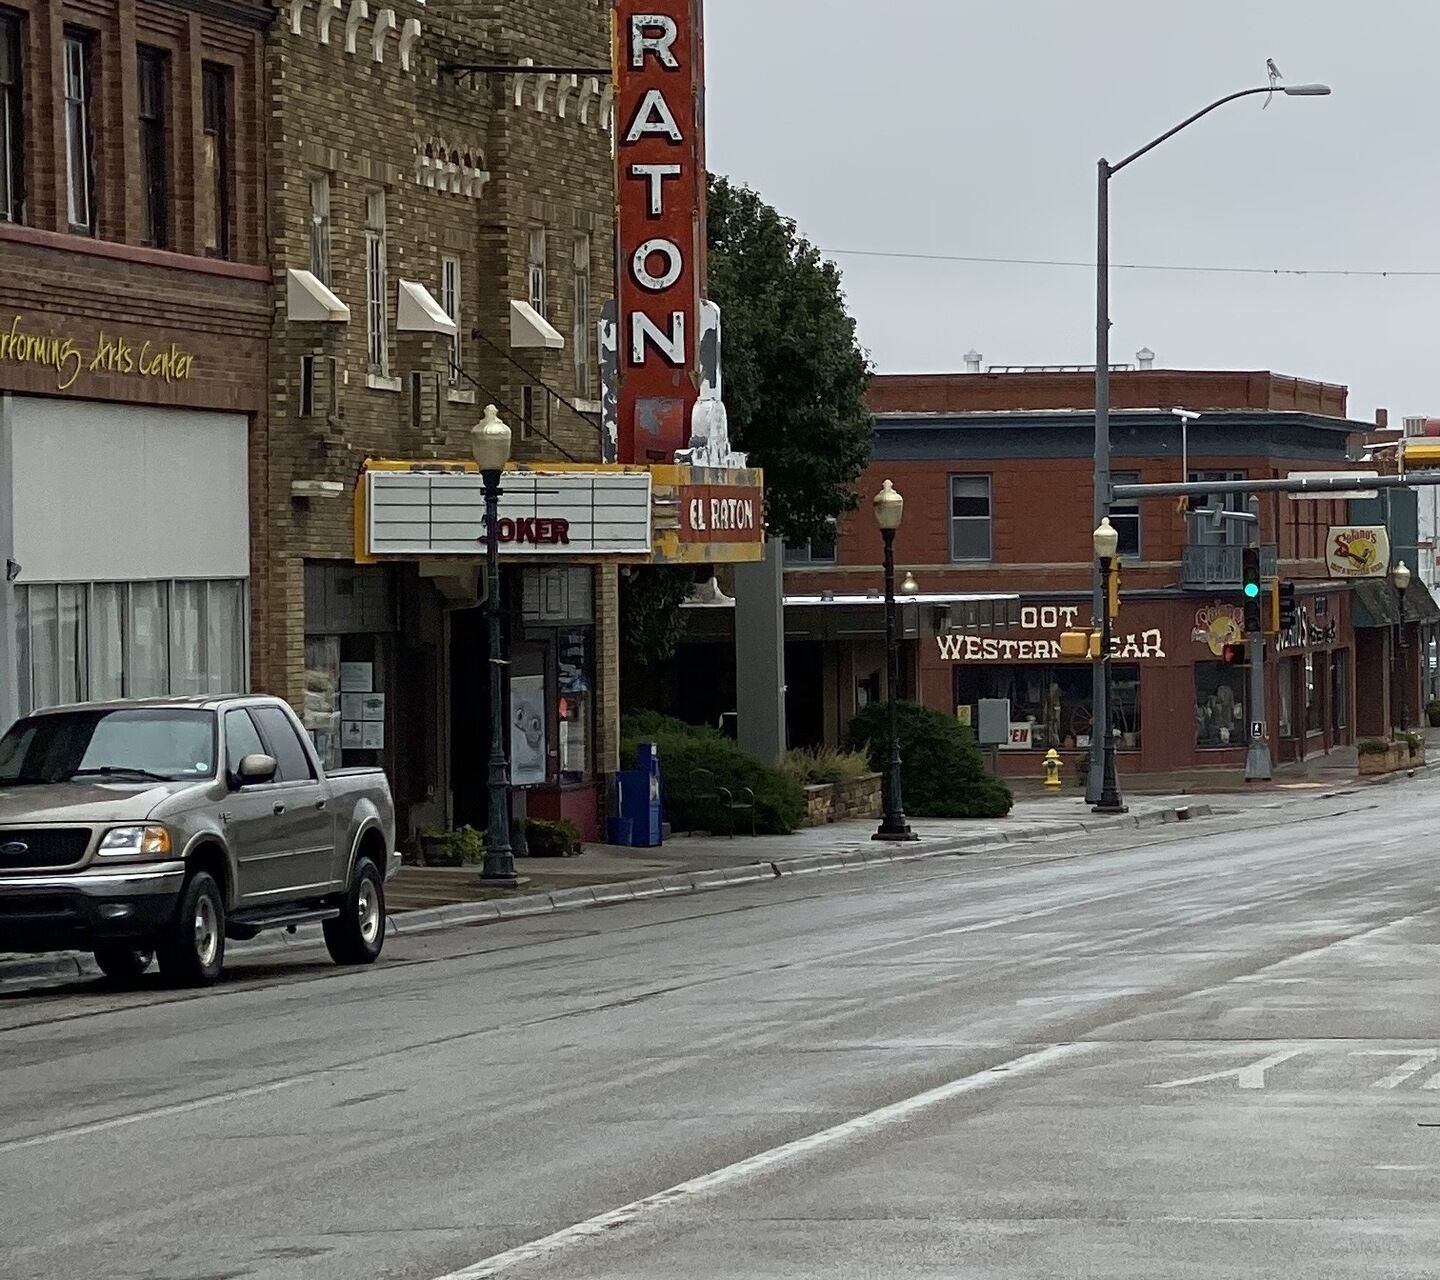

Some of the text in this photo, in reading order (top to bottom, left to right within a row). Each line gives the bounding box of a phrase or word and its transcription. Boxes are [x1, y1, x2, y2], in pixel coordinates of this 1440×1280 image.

[626, 14, 686, 363] RATON
[90, 330, 133, 373] Arts
[139, 340, 194, 384] Center
[689, 498, 753, 530] EL RATON
[478, 517, 570, 545] OKER
[1085, 628, 1166, 659] EAR
